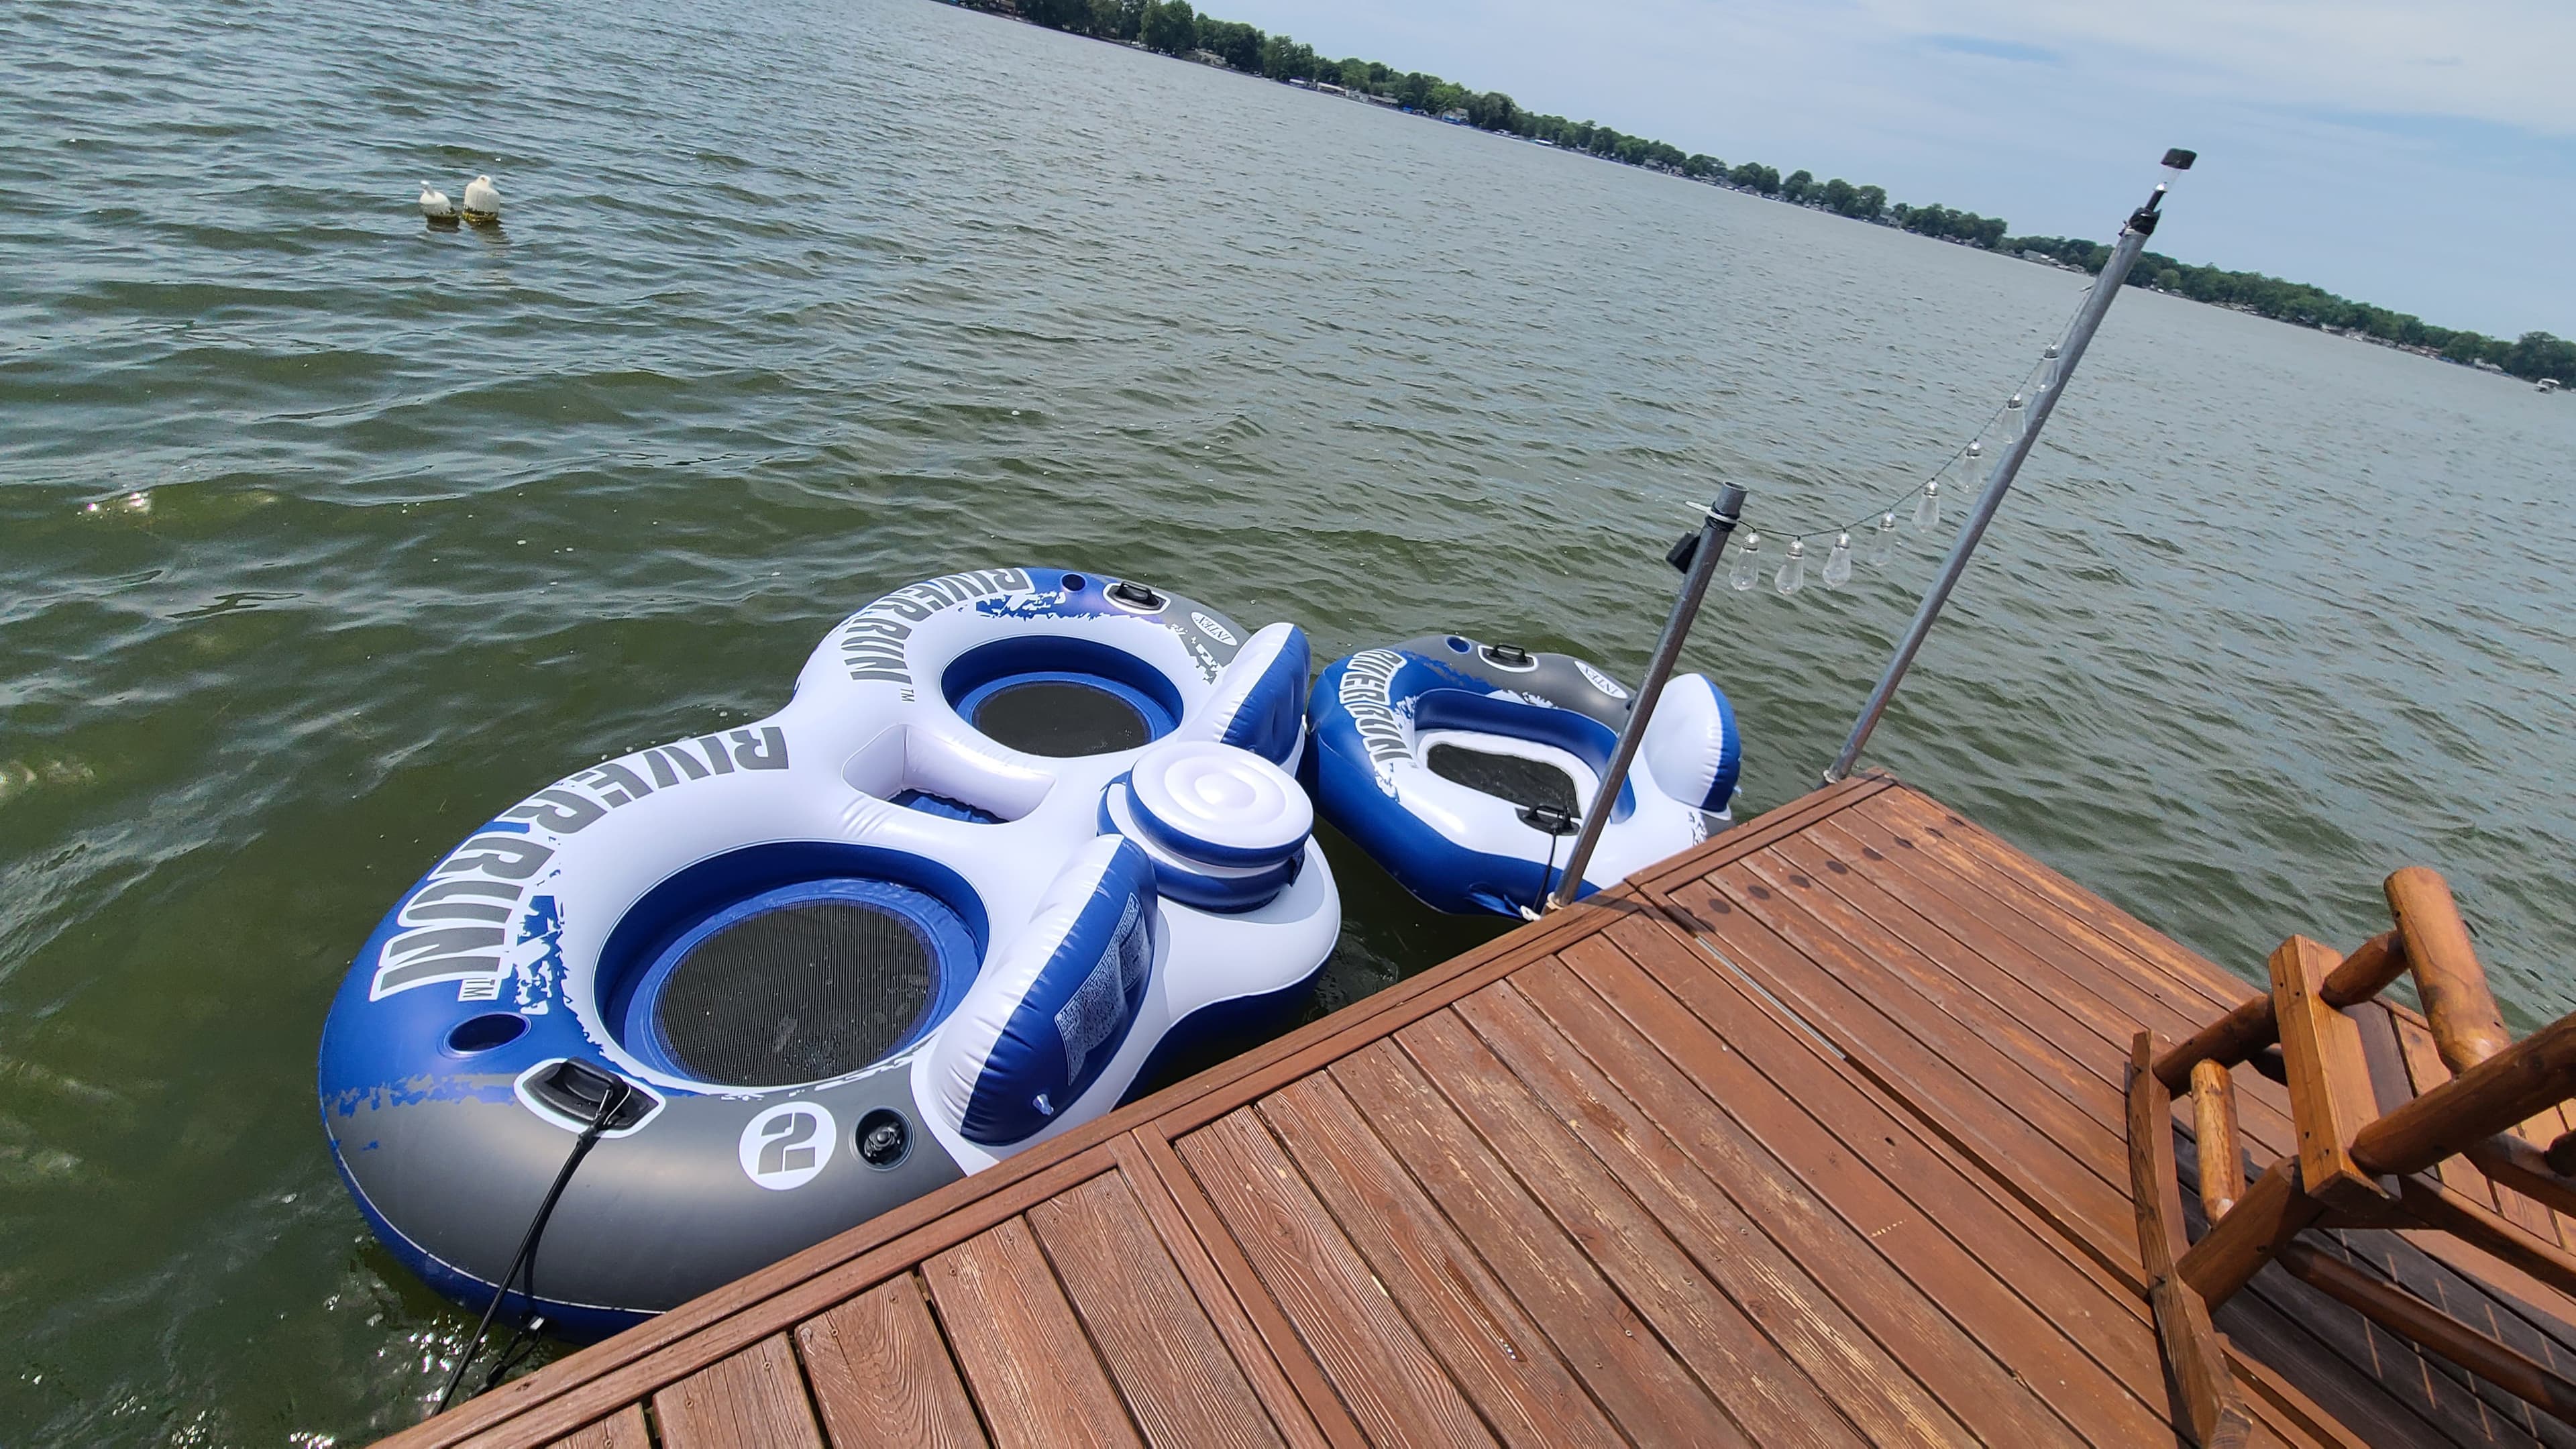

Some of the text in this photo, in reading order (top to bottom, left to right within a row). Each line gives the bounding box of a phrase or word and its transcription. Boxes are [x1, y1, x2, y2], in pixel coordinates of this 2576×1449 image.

[866, 568, 1030, 622] RIVER
[1194, 616, 1232, 641] INTEX
[840, 617, 913, 685] RUN
[1344, 649, 1413, 763] RIVER RUN
[501, 727, 789, 834] RIVER
[379, 836, 555, 992] RUN
[757, 1112, 817, 1176] 2
